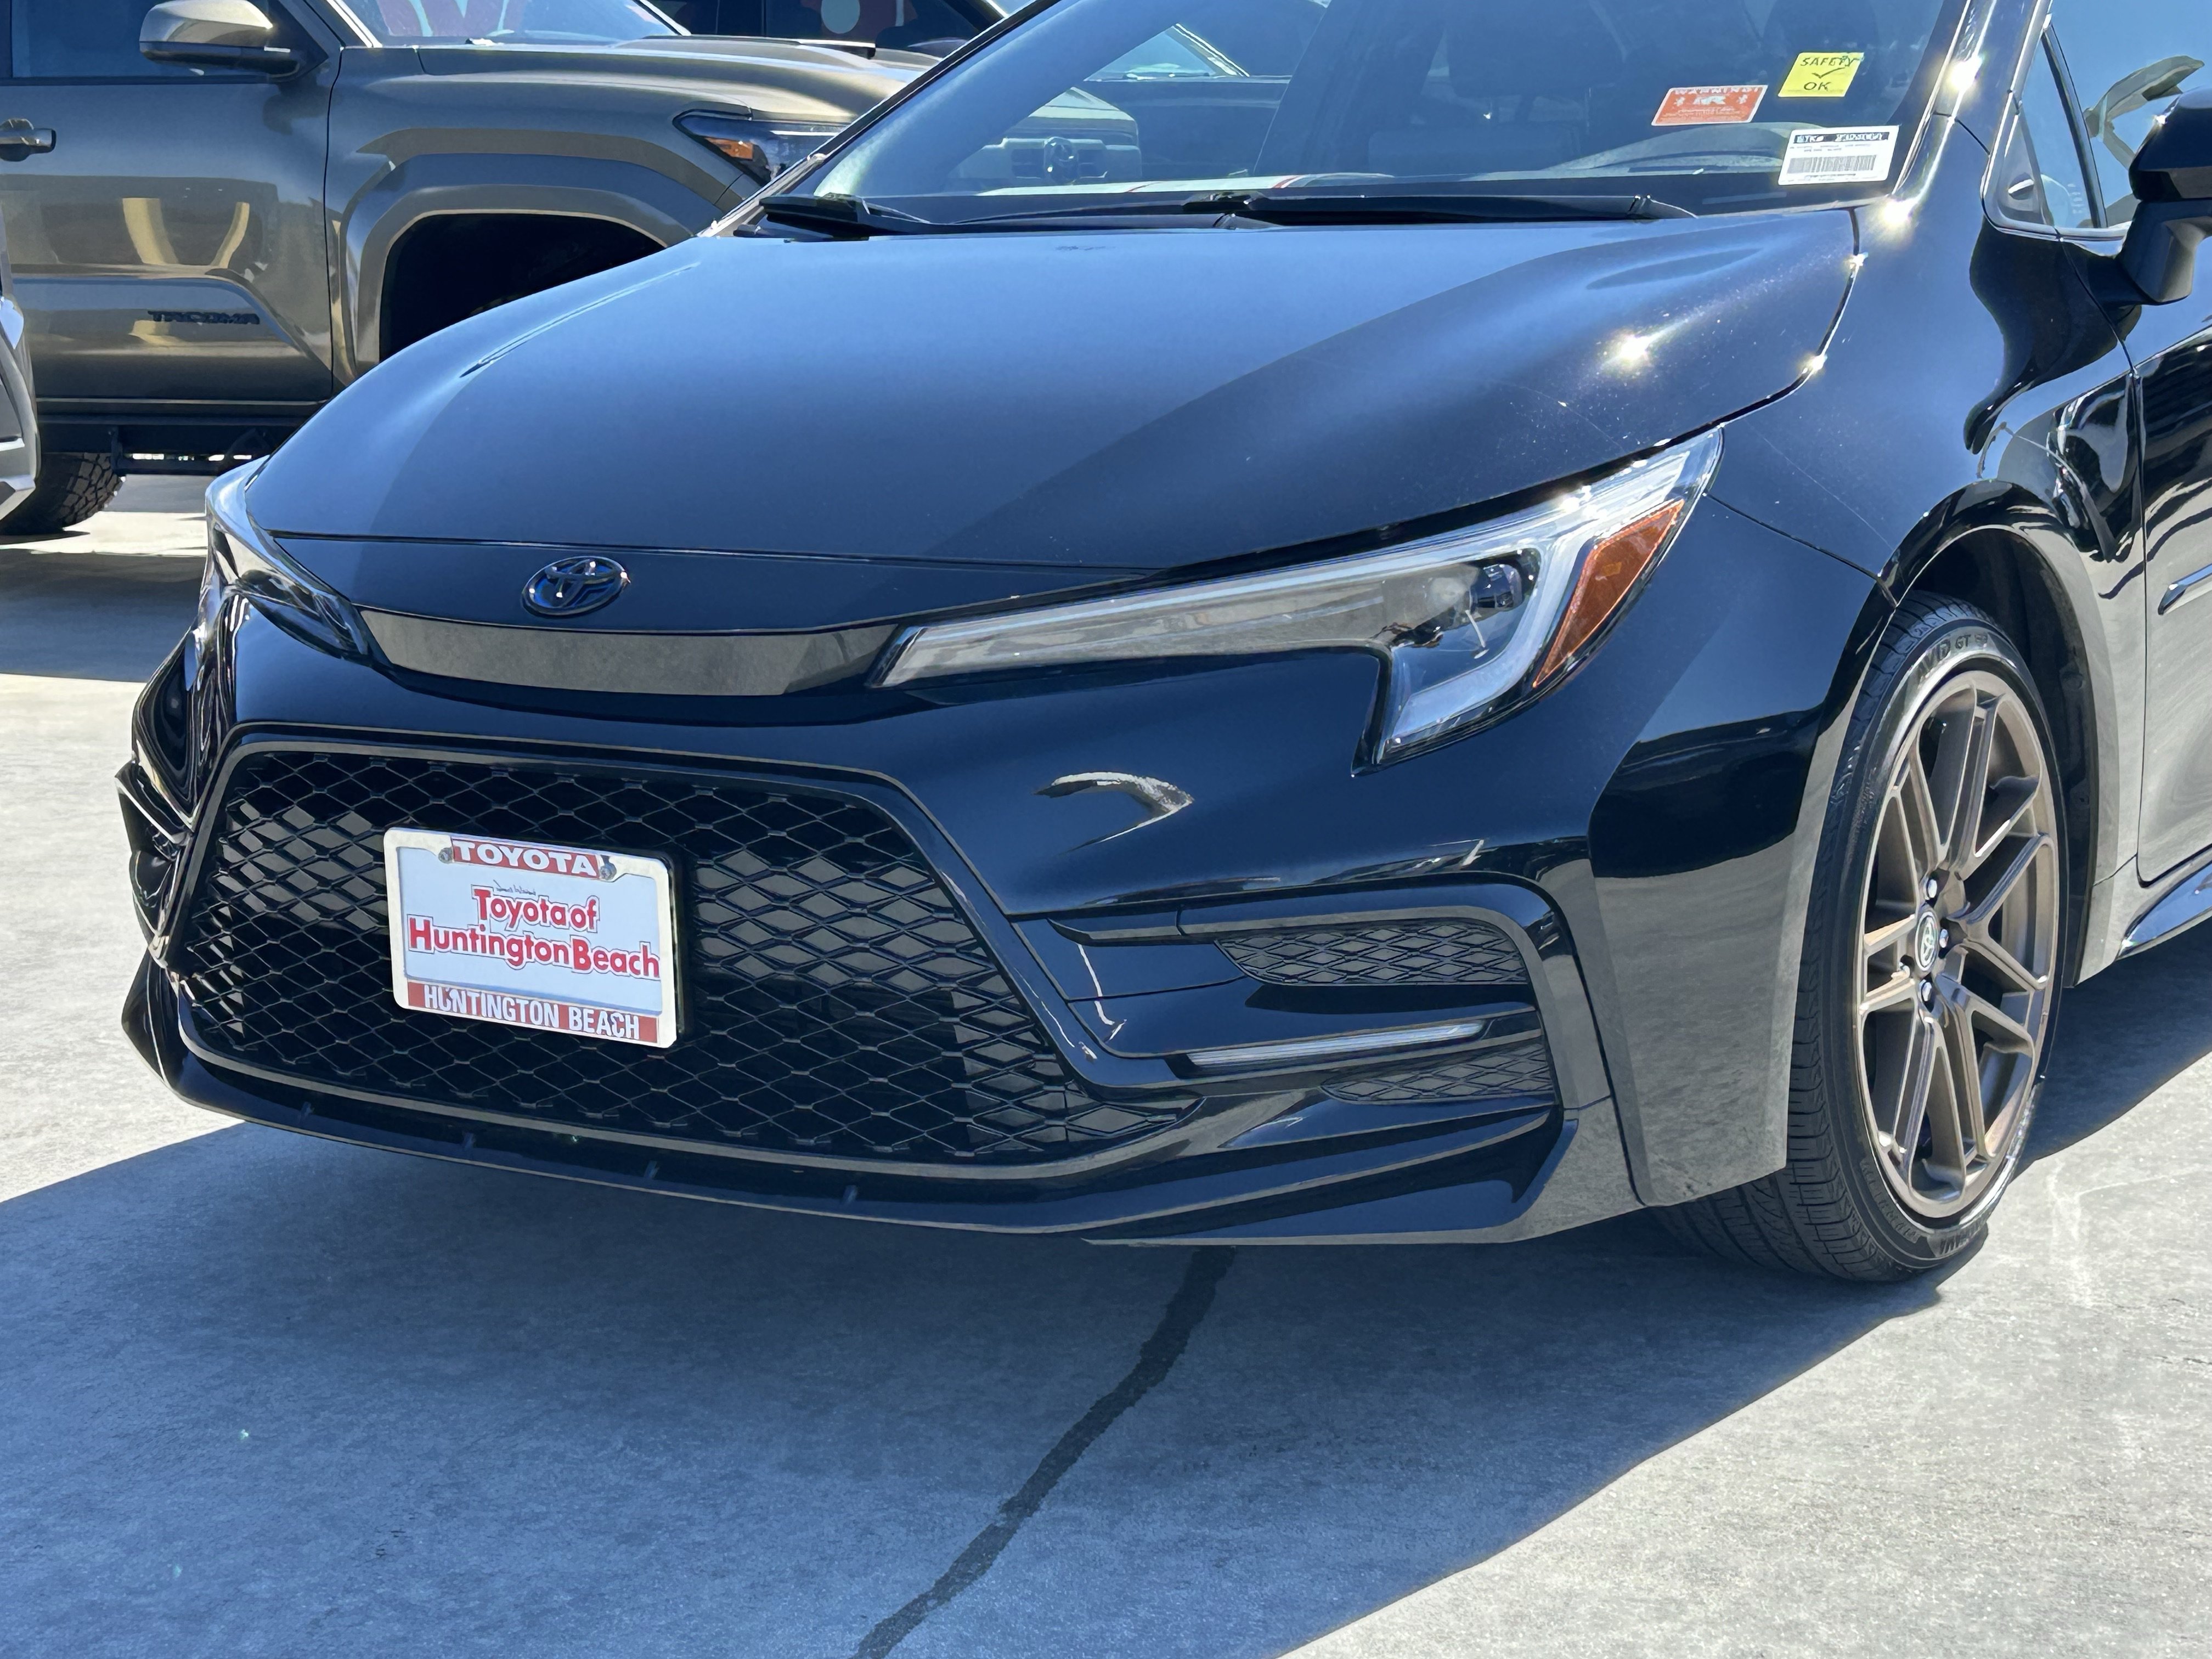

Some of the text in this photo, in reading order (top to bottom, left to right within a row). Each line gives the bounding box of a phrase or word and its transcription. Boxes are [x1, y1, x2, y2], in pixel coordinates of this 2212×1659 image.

[1803, 82, 1831, 91] OK
[148, 311, 261, 325] TACOMA
[453, 840, 597, 876] TOYOTA
[473, 889, 596, 930] Toyota of
[409, 917, 659, 978] Huntington Beach
[424, 985, 639, 1039] HUNTINGTON BEACH
